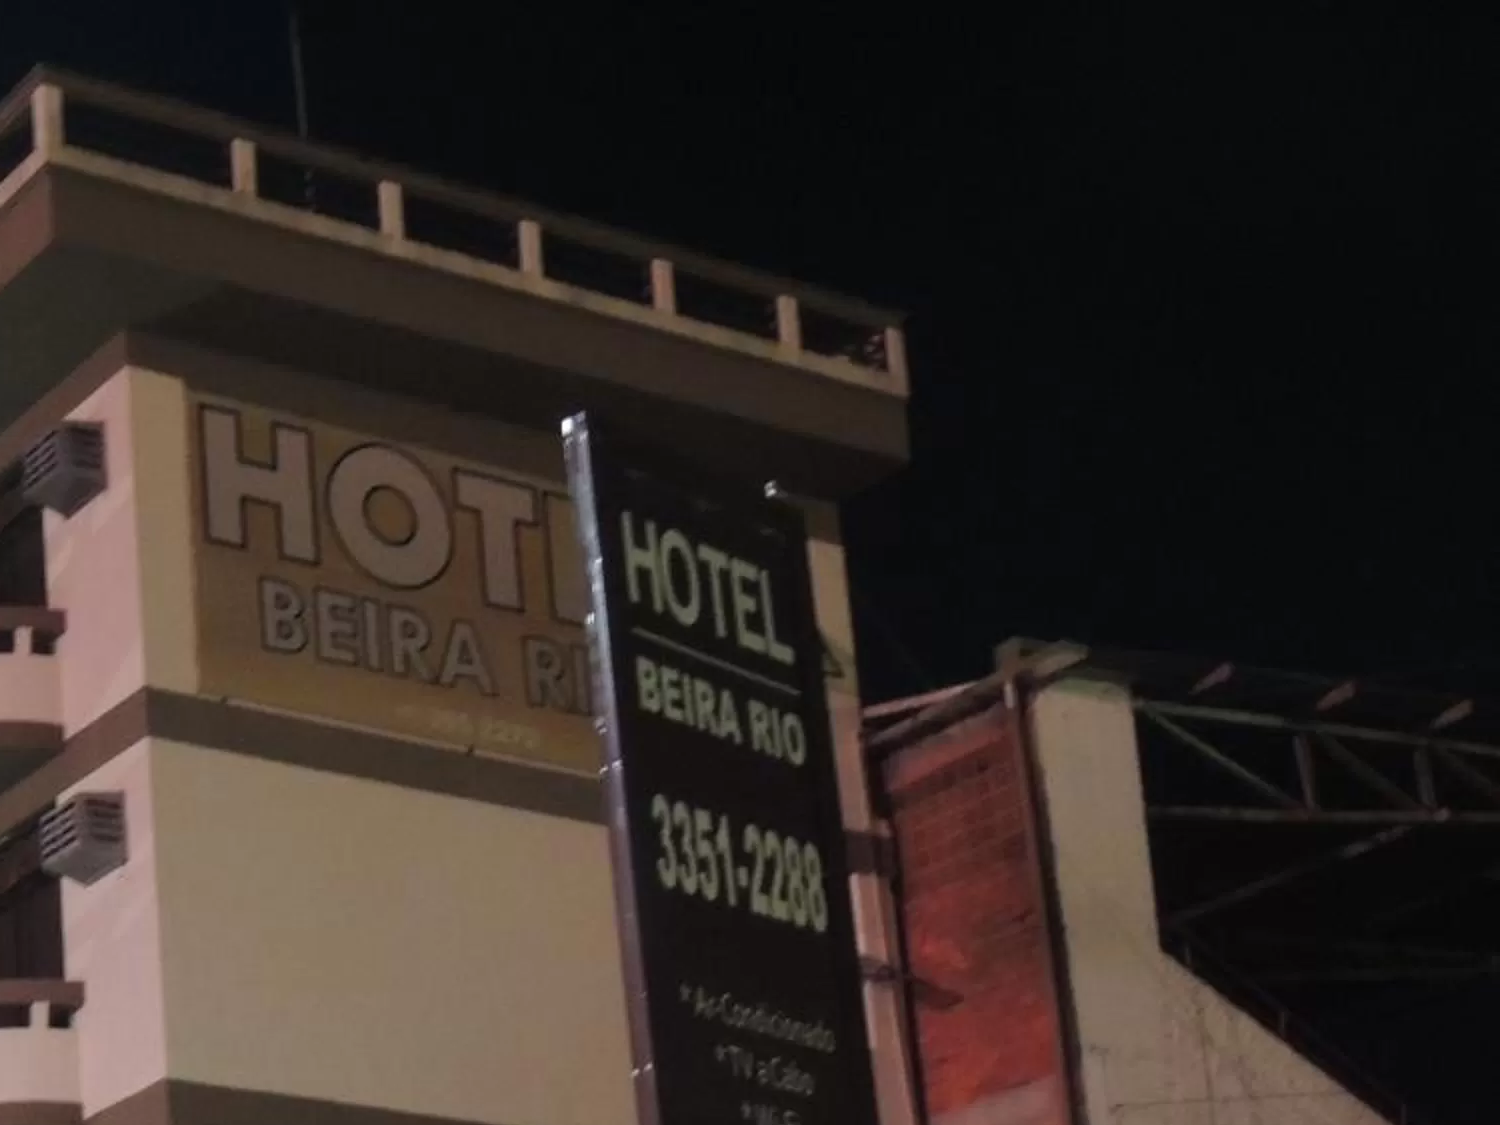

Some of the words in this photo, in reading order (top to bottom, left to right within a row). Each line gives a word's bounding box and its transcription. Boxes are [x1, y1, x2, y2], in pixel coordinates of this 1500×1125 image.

[200, 402, 590, 628] HOT
[257, 575, 500, 697] BEIRA
[523, 635, 595, 716] RI
[620, 511, 796, 665] HOTEL
[635, 656, 743, 745] BEIRA
[748, 698, 807, 767] RIO
[651, 793, 828, 933] 3351-2288
